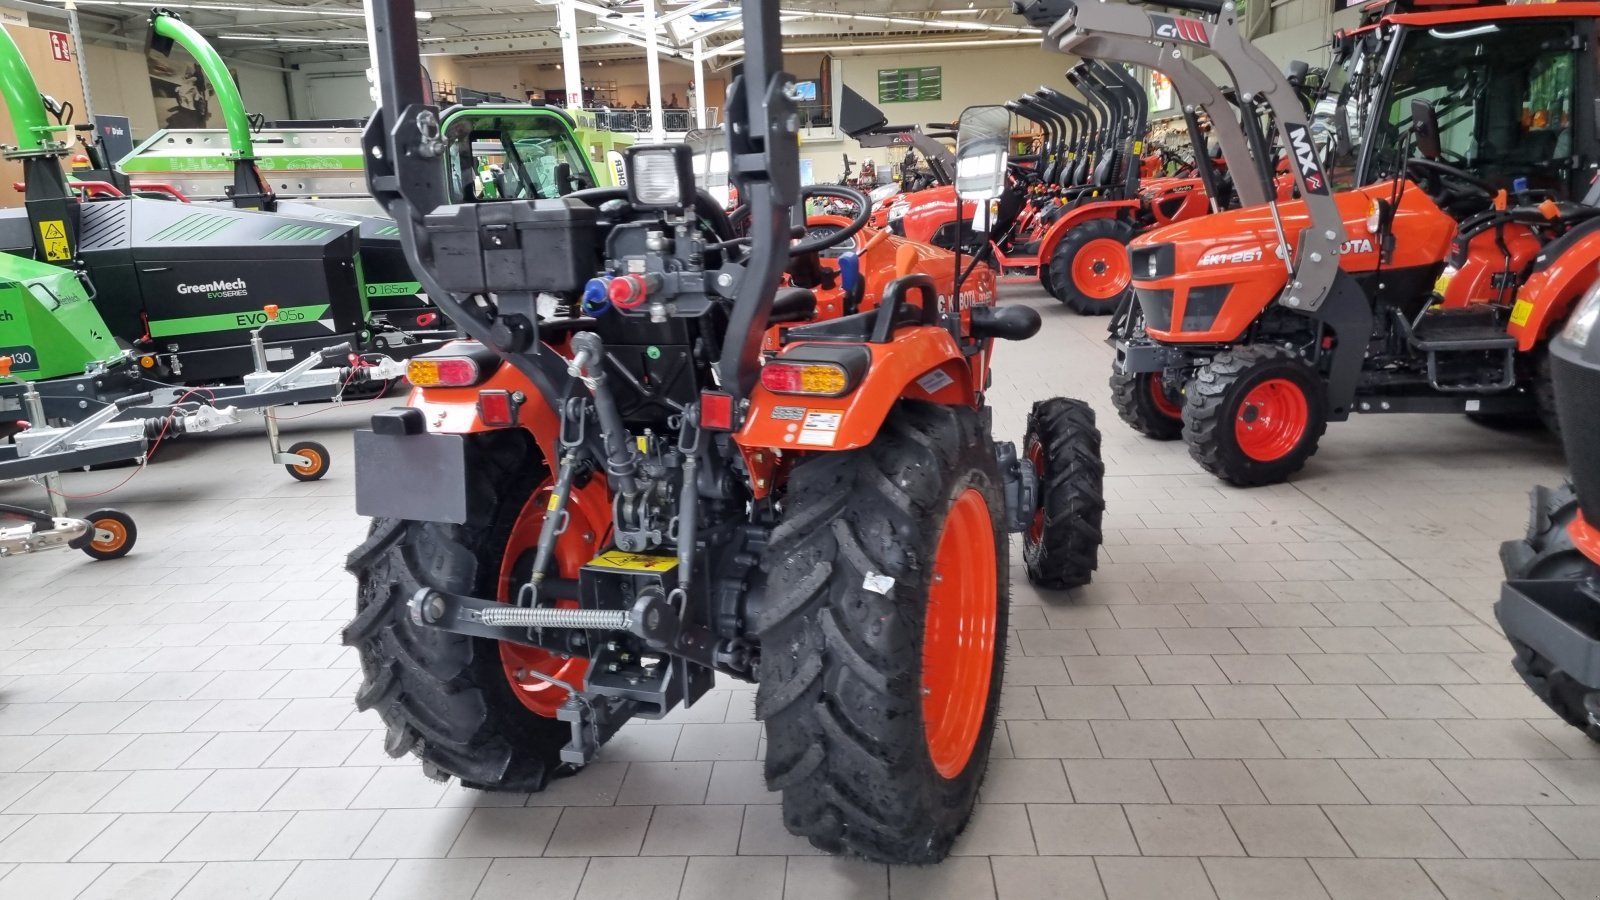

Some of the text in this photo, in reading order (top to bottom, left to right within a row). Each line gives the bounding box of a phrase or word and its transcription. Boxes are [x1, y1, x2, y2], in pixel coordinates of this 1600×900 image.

[1289, 127, 1318, 176] MX
[177, 277, 247, 294] GreenMech
[236, 312, 269, 327] EVO
